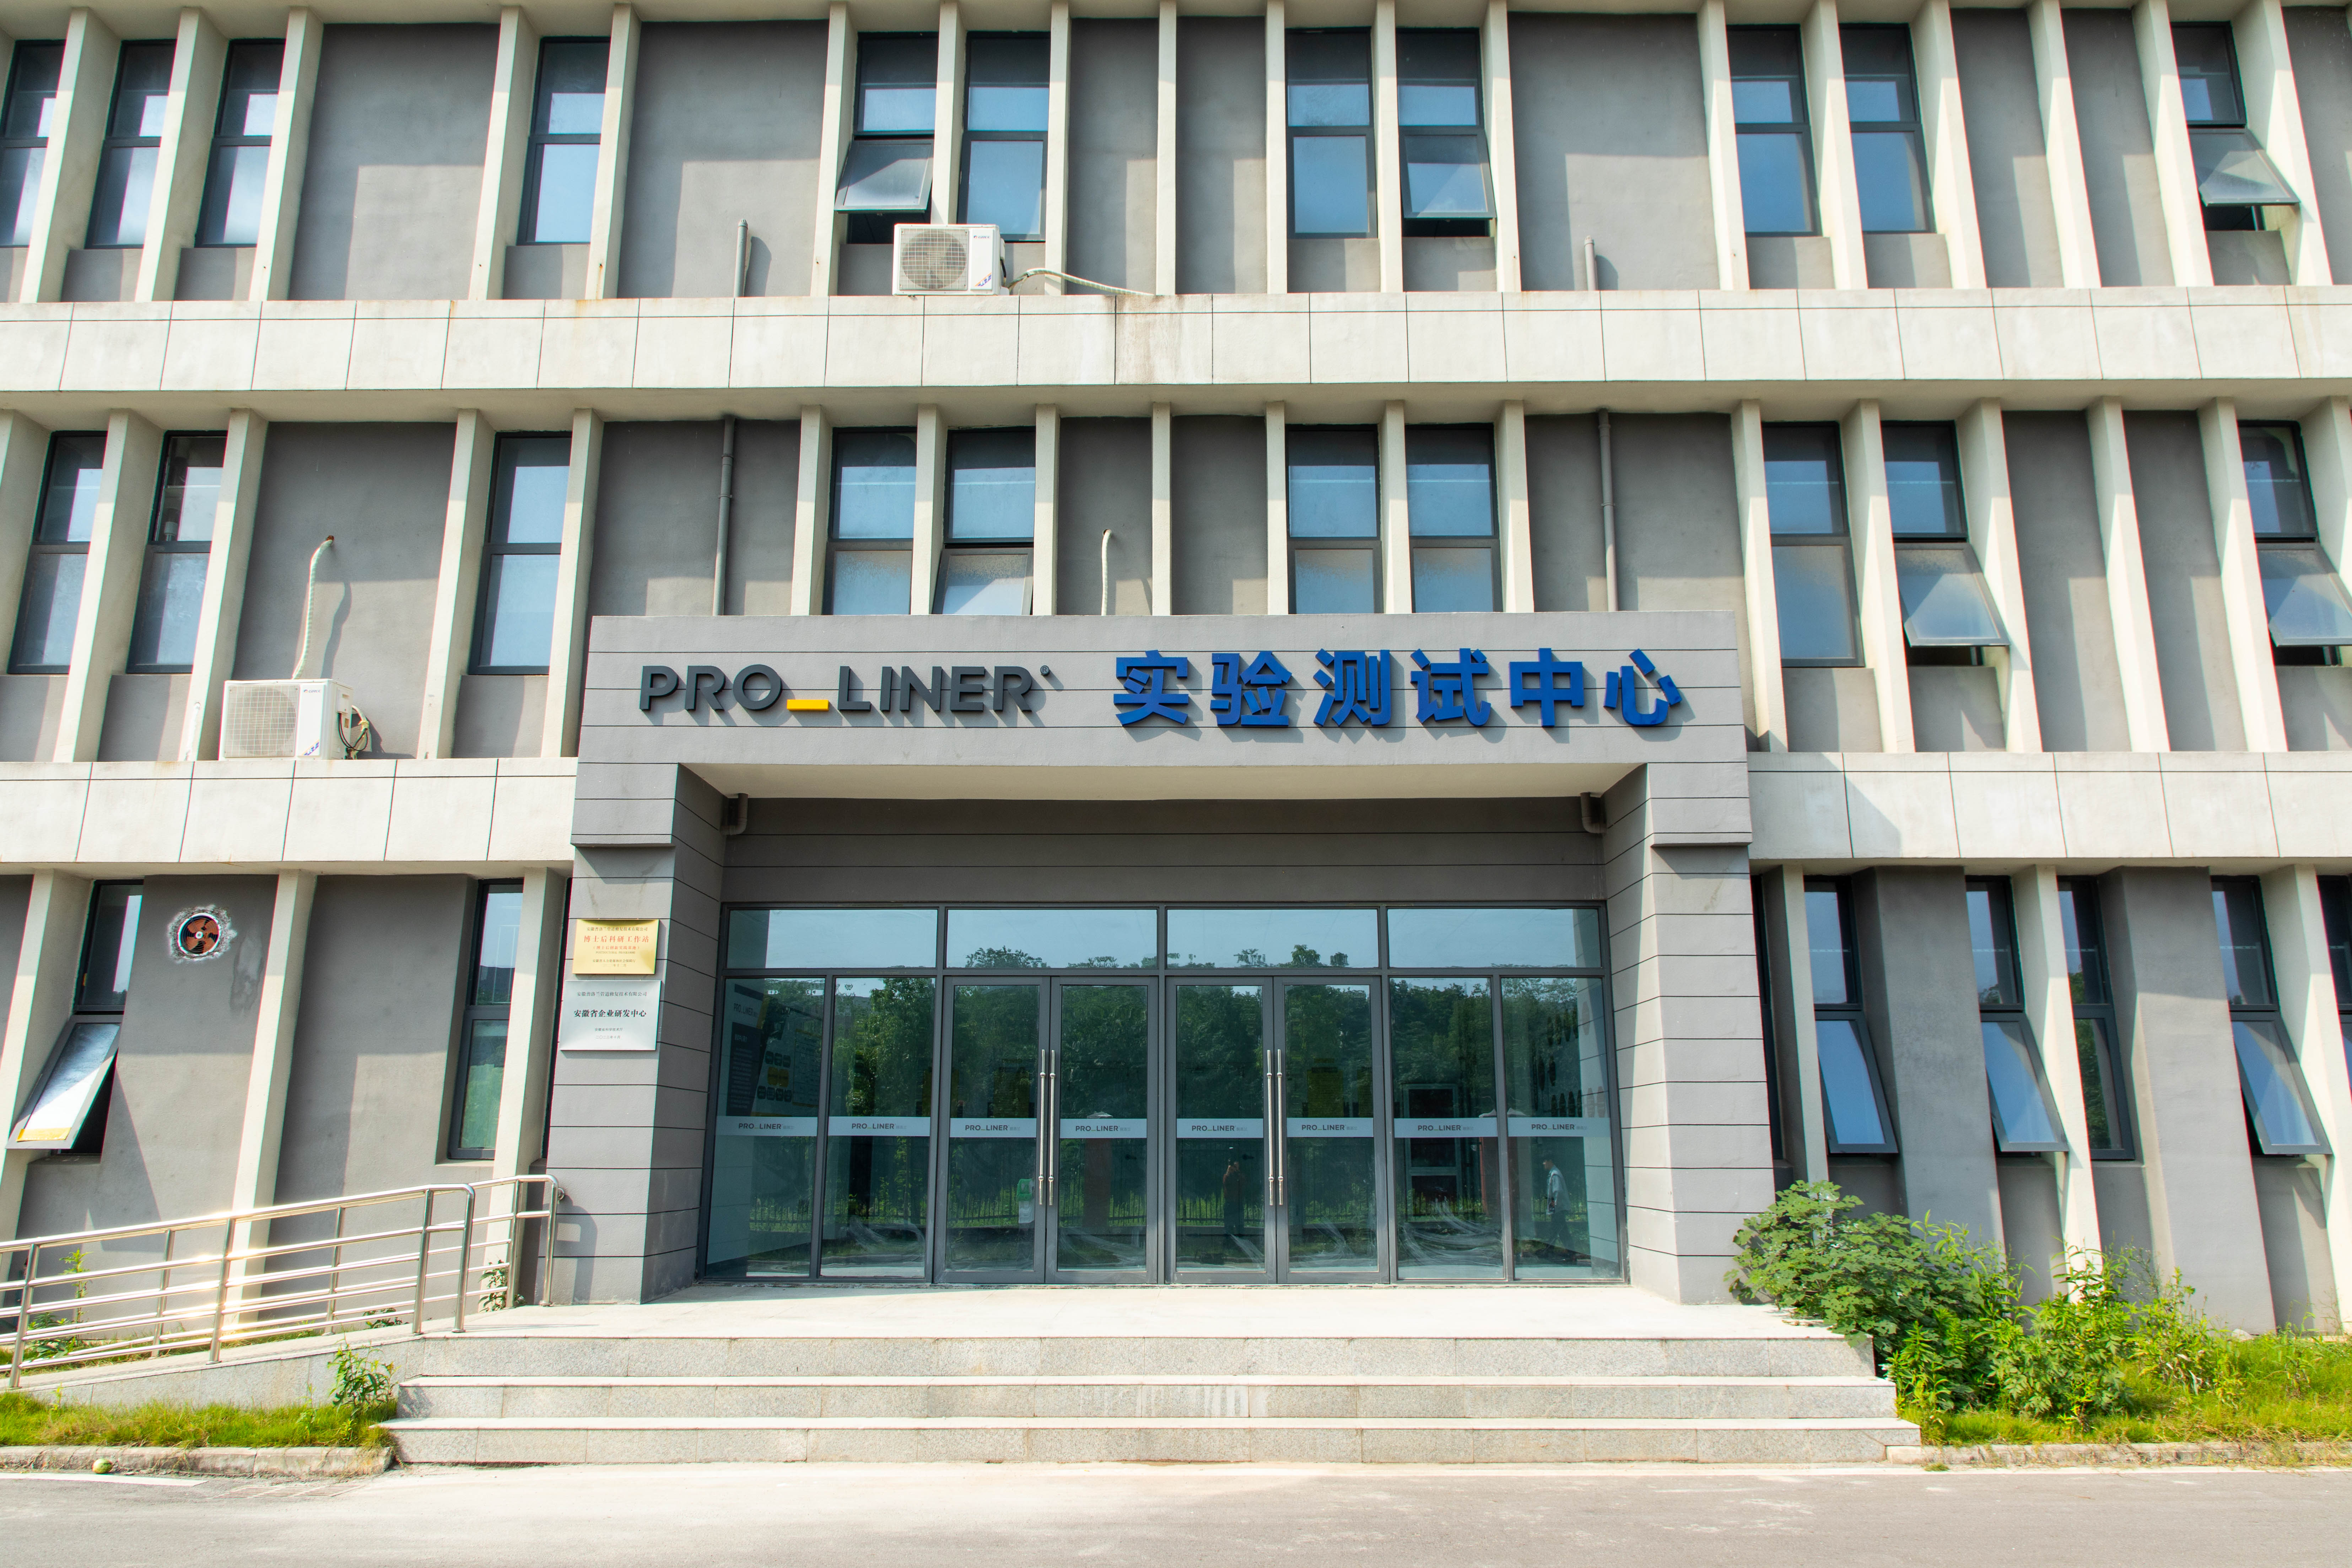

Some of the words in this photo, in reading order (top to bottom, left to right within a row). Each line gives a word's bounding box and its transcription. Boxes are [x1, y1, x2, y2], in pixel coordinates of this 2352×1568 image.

[1113, 647, 1682, 727] 实验测试中心
[574, 1009, 647, 1018] 安徽省企业研发中心
